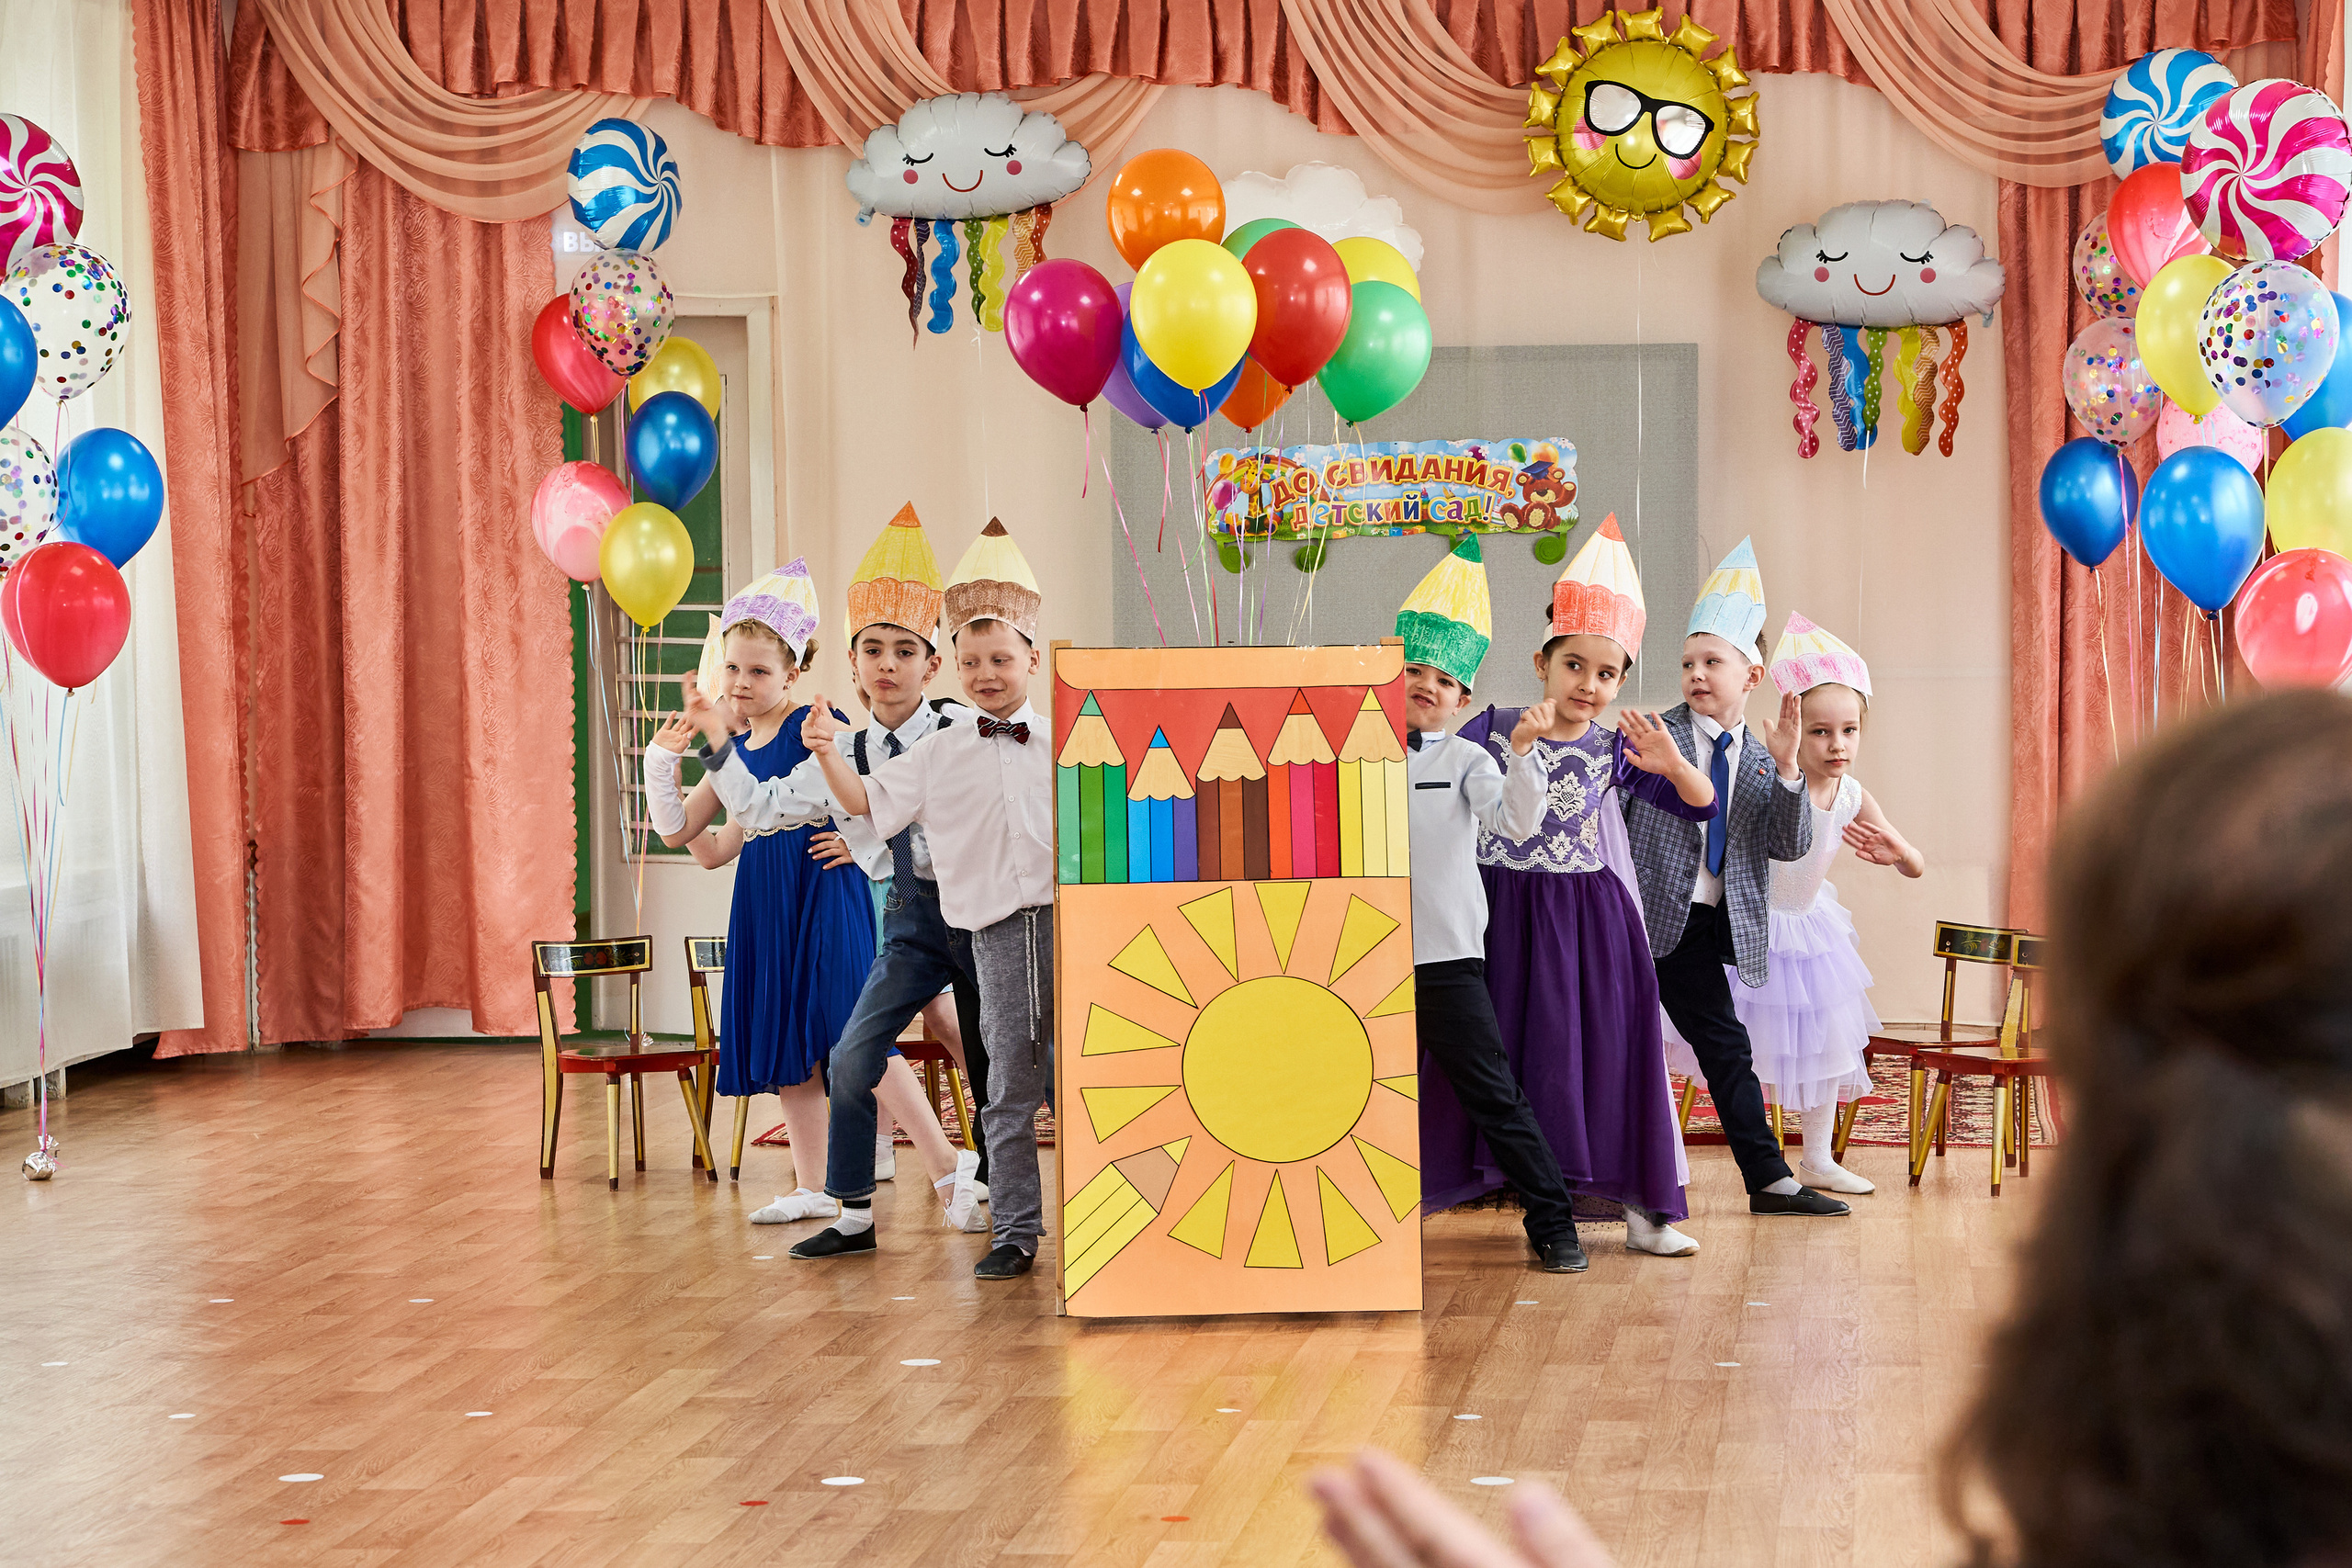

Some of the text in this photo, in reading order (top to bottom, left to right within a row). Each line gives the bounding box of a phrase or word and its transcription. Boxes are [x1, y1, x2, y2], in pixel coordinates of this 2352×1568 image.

[1272, 457, 1515, 509] ДО СВИДАНИЯ,
[1427, 493, 1493, 522] сад!
